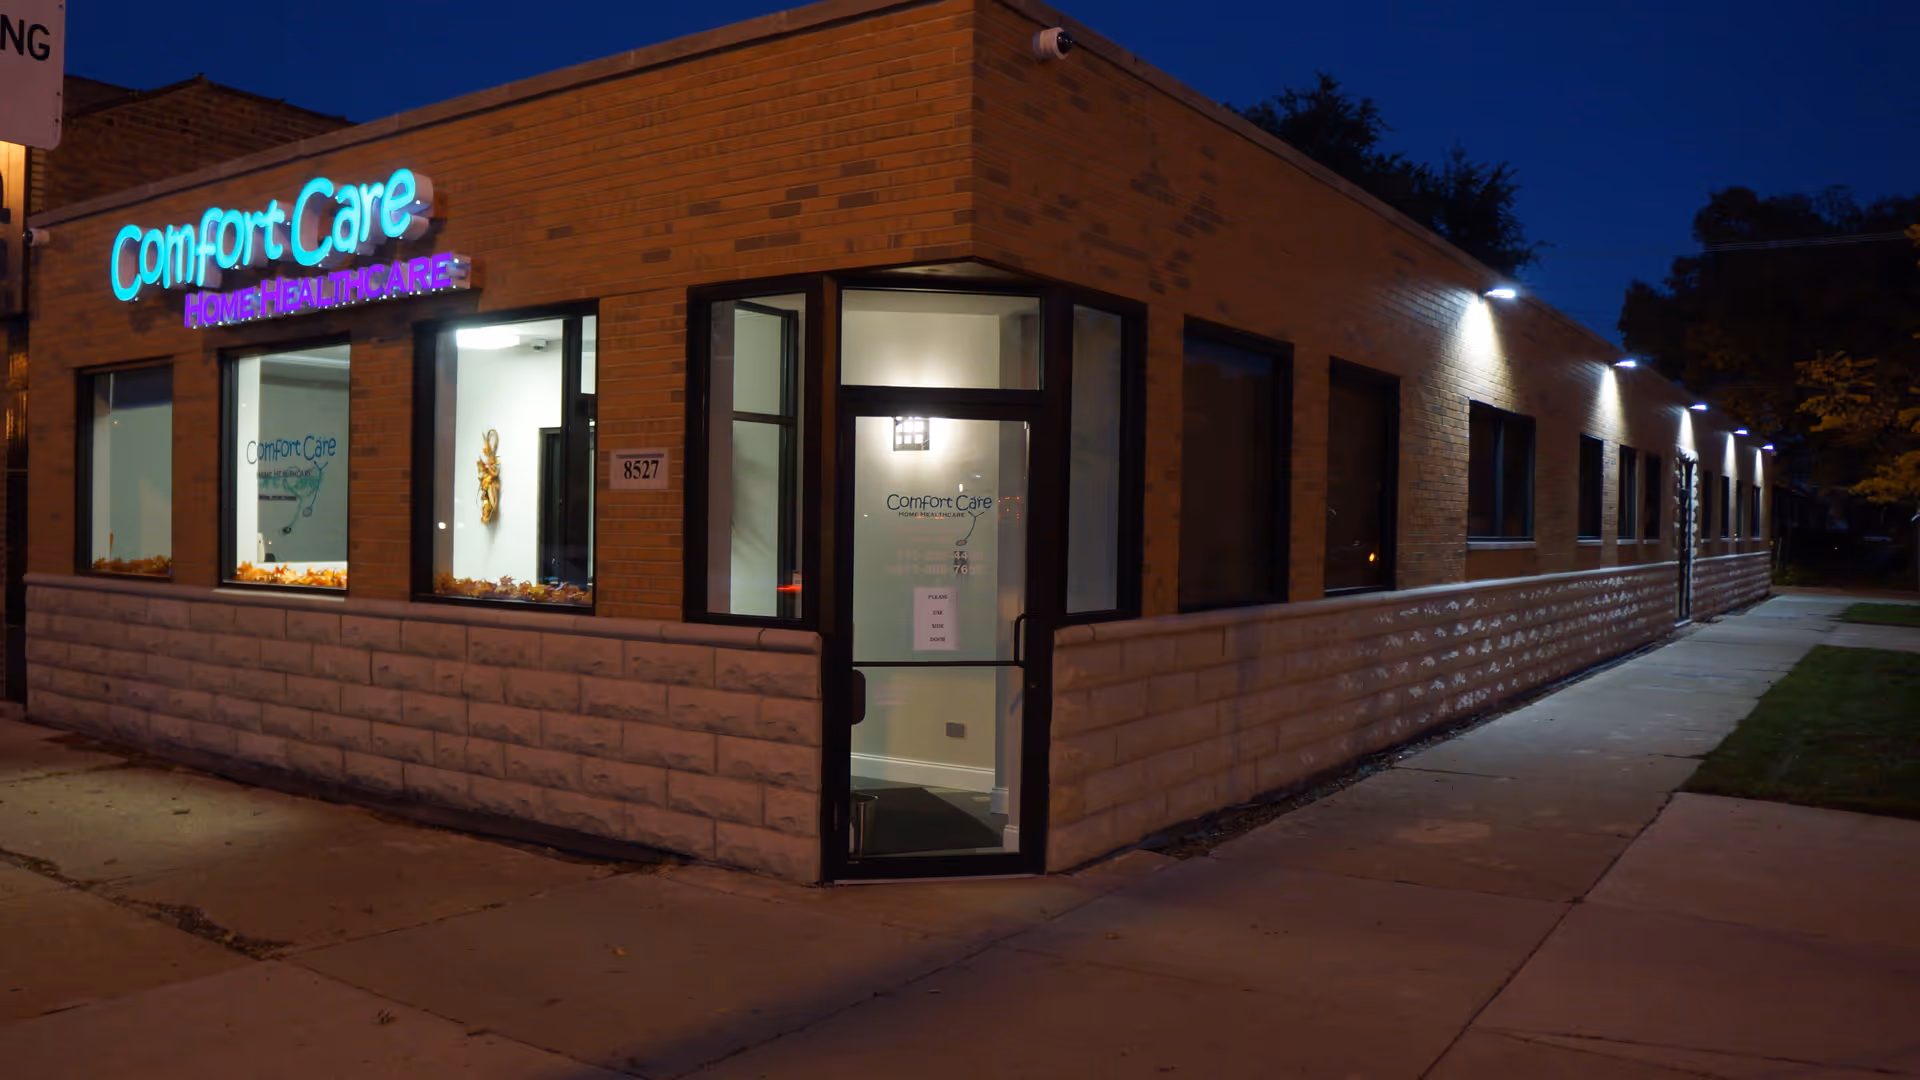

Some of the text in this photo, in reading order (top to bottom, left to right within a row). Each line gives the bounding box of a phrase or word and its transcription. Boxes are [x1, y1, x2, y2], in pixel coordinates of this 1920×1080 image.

[110, 168, 418, 302] Comfort Care
[184, 252, 454, 329] HOME HEALTHCARE
[247, 435, 336, 464] Comfort Care
[623, 459, 659, 480] 8527
[886, 493, 992, 511] Comfort Care
